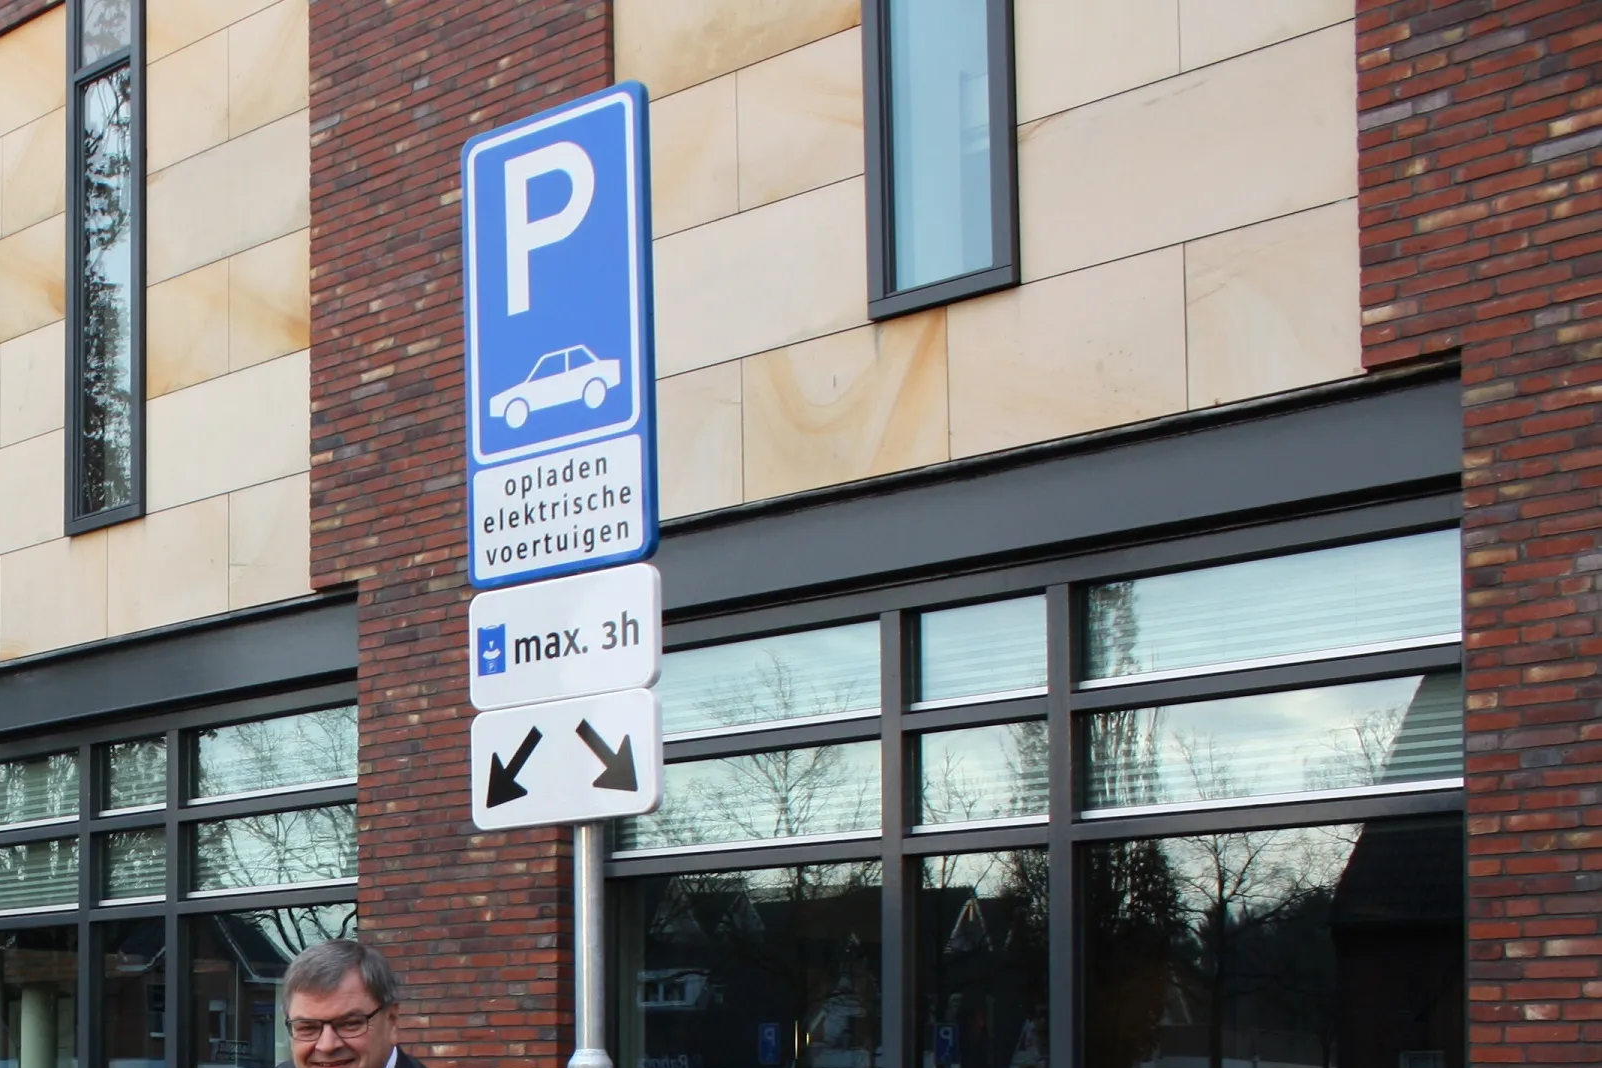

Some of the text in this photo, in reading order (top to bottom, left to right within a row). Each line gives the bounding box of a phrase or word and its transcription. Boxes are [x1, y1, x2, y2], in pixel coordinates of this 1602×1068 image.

[505, 141, 595, 316] P
[504, 456, 608, 499] opladen
[483, 484, 632, 534] elektrische
[486, 519, 629, 566] voertuigen
[514, 609, 640, 664] max. 3h
